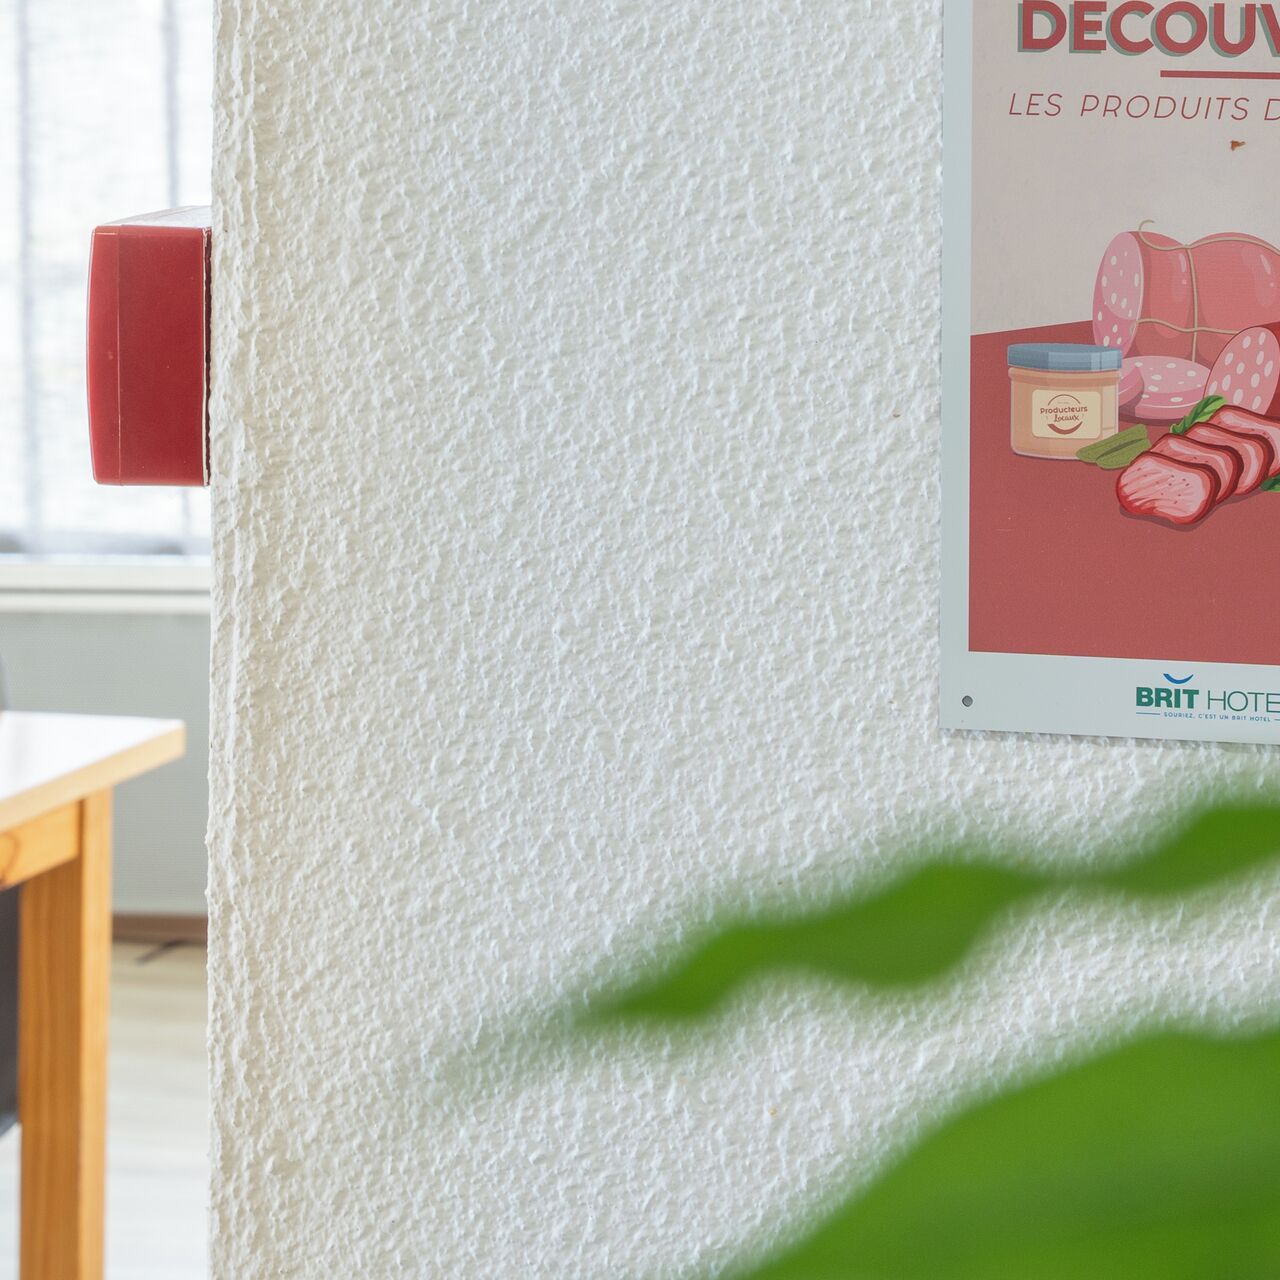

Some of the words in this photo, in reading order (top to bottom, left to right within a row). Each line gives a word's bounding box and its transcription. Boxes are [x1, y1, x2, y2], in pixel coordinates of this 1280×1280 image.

[1009, 93, 1062, 117] LES
[1080, 94, 1250, 121] PRODUITS
[1040, 406, 1088, 415] Producteurs
[1136, 686, 1200, 709] BRIT
